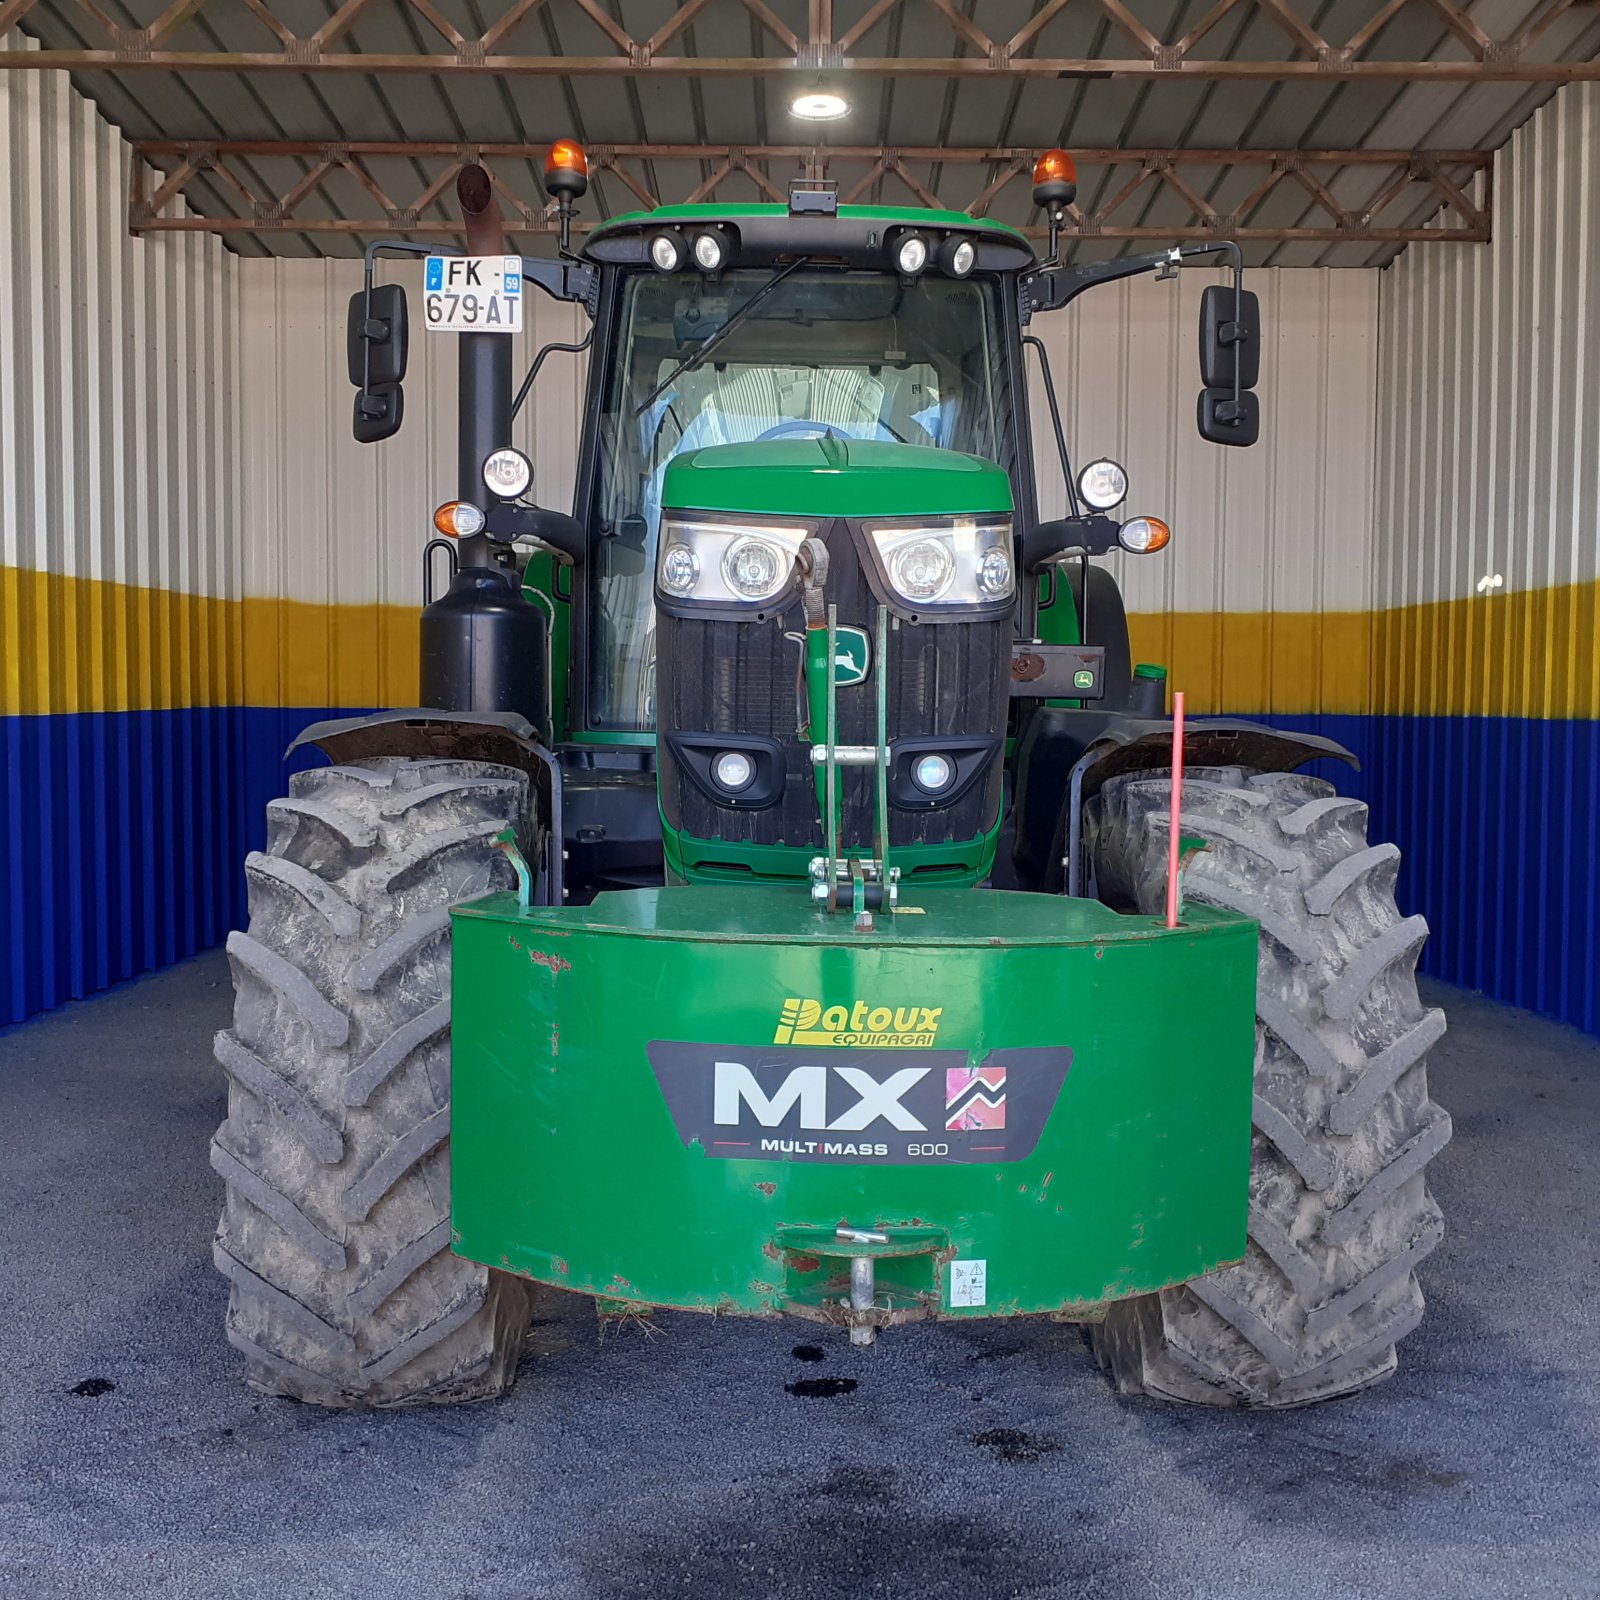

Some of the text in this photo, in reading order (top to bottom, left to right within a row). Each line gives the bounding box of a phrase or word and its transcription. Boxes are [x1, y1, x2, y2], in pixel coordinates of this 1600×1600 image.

[505, 277, 518, 289] 59
[426, 294, 519, 324] 679-AT
[774, 999, 943, 1044] Patoux
[832, 1034, 932, 1046] EQUIPAGRI
[714, 1062, 932, 1131] MX
[761, 1139, 949, 1156] MULTIMASS 600
